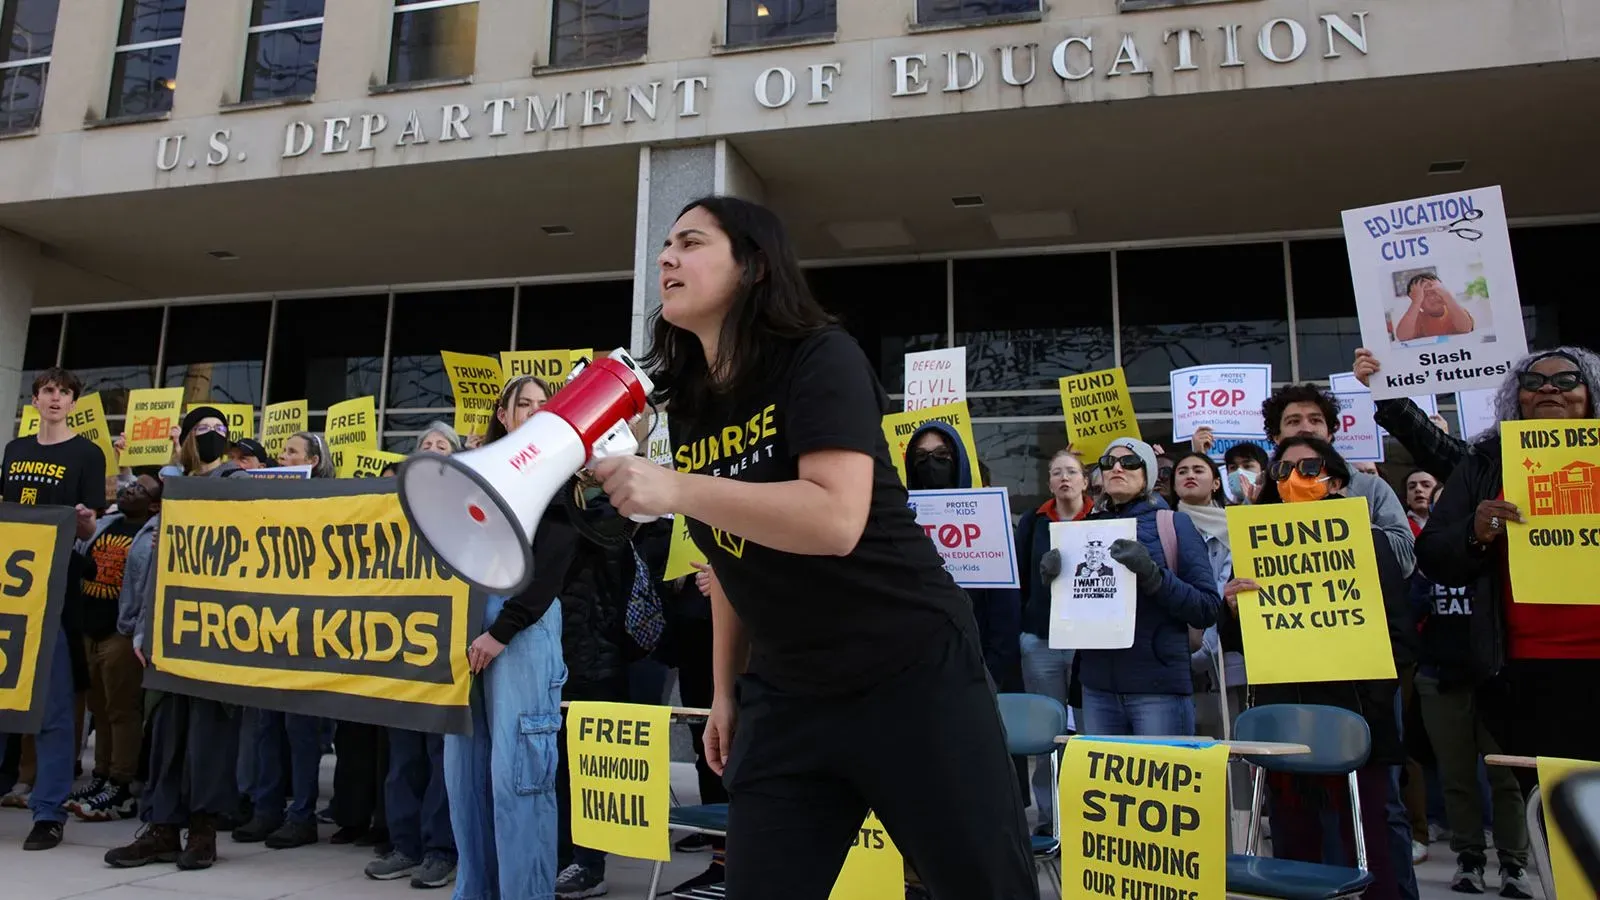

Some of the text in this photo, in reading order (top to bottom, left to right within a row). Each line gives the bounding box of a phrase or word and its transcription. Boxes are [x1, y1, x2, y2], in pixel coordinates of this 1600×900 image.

[155, 11, 1370, 171] U.S. DEPARTMENT OF EDUCATION
[1363, 195, 1474, 239] EDUCATION
[1381, 236, 1429, 261] CUTS
[511, 359, 563, 376] FUND
[912, 361, 951, 371] DEFEND
[1419, 349, 1472, 366] Slash
[453, 366, 497, 379] TRUMP:
[458, 382, 500, 395] STOP
[908, 378, 955, 395] CIVIL
[1068, 373, 1114, 393] FUND
[1070, 389, 1118, 408] EDUCATION
[1187, 389, 1245, 409] STOP
[268, 408, 301, 422] FUND
[331, 412, 365, 430] FREE
[1073, 405, 1124, 425] NOT 1%
[330, 431, 366, 446] MAHMOUD
[675, 404, 777, 473] SUNRISE
[895, 421, 917, 436] KIDS
[1076, 420, 1127, 438] TAX CUTS
[1520, 428, 1600, 449] KIDS DES
[265, 438, 283, 449] NOT
[9, 461, 66, 479] SUNRISE
[9, 475, 60, 486] MOVEMENT
[921, 524, 981, 548] TOP
[1249, 518, 1350, 549] FUND
[1529, 529, 1574, 546] GOOD
[167, 524, 249, 578] TRUMP:
[256, 525, 316, 580] STOP
[952, 551, 1003, 559] EDUCATION!
[1253, 548, 1356, 578] EDUCATION
[1073, 577, 1116, 587] I WANT YOU
[1258, 578, 1361, 607] NOT 1%
[1261, 608, 1365, 630] TAX CUTS
[172, 600, 440, 667] FROM KIDS
[579, 717, 651, 746] FREE
[579, 754, 649, 782] MAHMOUD
[1088, 751, 1202, 793] TRUMP:
[582, 788, 649, 827] KHALIL
[1083, 789, 1200, 836] STOP
[1083, 831, 1200, 880] DEFUNDING
[1083, 869, 1116, 897] OUR
